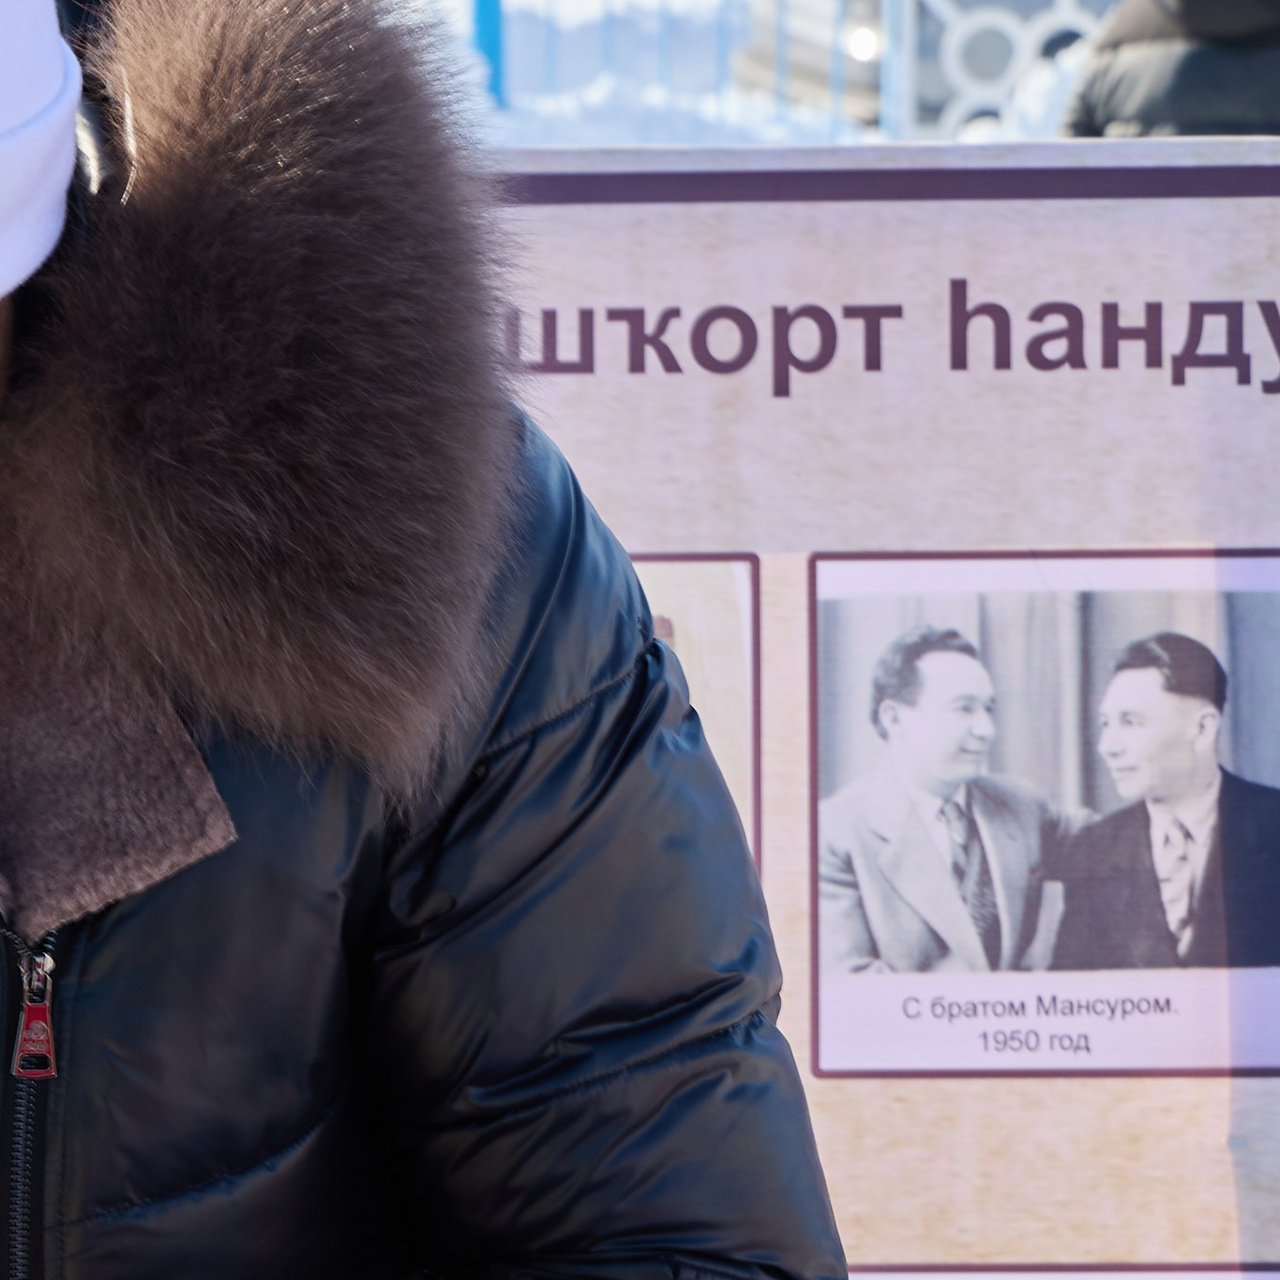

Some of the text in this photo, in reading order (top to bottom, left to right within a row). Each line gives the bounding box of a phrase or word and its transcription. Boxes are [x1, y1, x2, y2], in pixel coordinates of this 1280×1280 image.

[902, 994, 1180, 1023] С братом Мансуром.
[978, 1030, 1091, 1054] 1950 год
